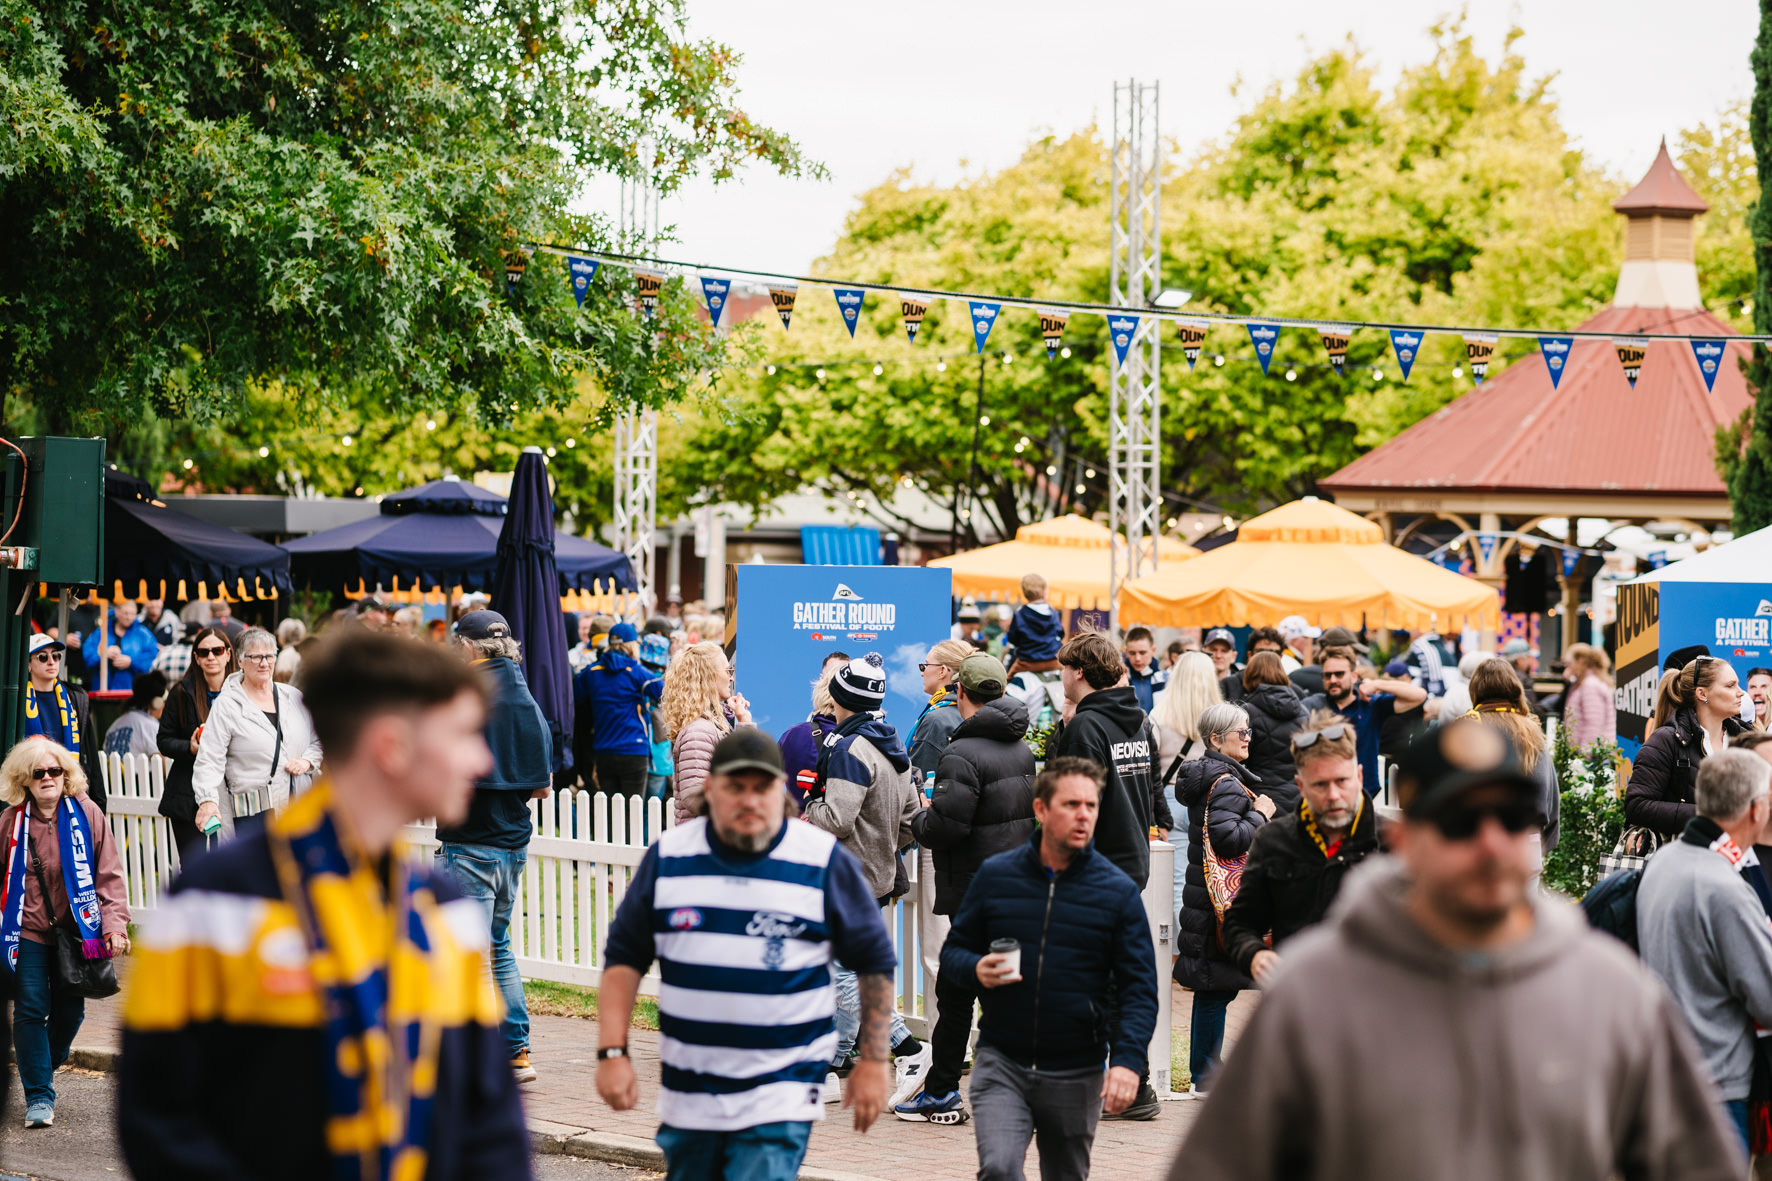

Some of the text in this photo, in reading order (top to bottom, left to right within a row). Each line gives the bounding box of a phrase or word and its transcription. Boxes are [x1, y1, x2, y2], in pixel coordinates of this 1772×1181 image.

[794, 602, 896, 624] GATHER ROUND
[864, 624, 895, 632] FOOTY
[1715, 618, 1769, 640] GATHER
